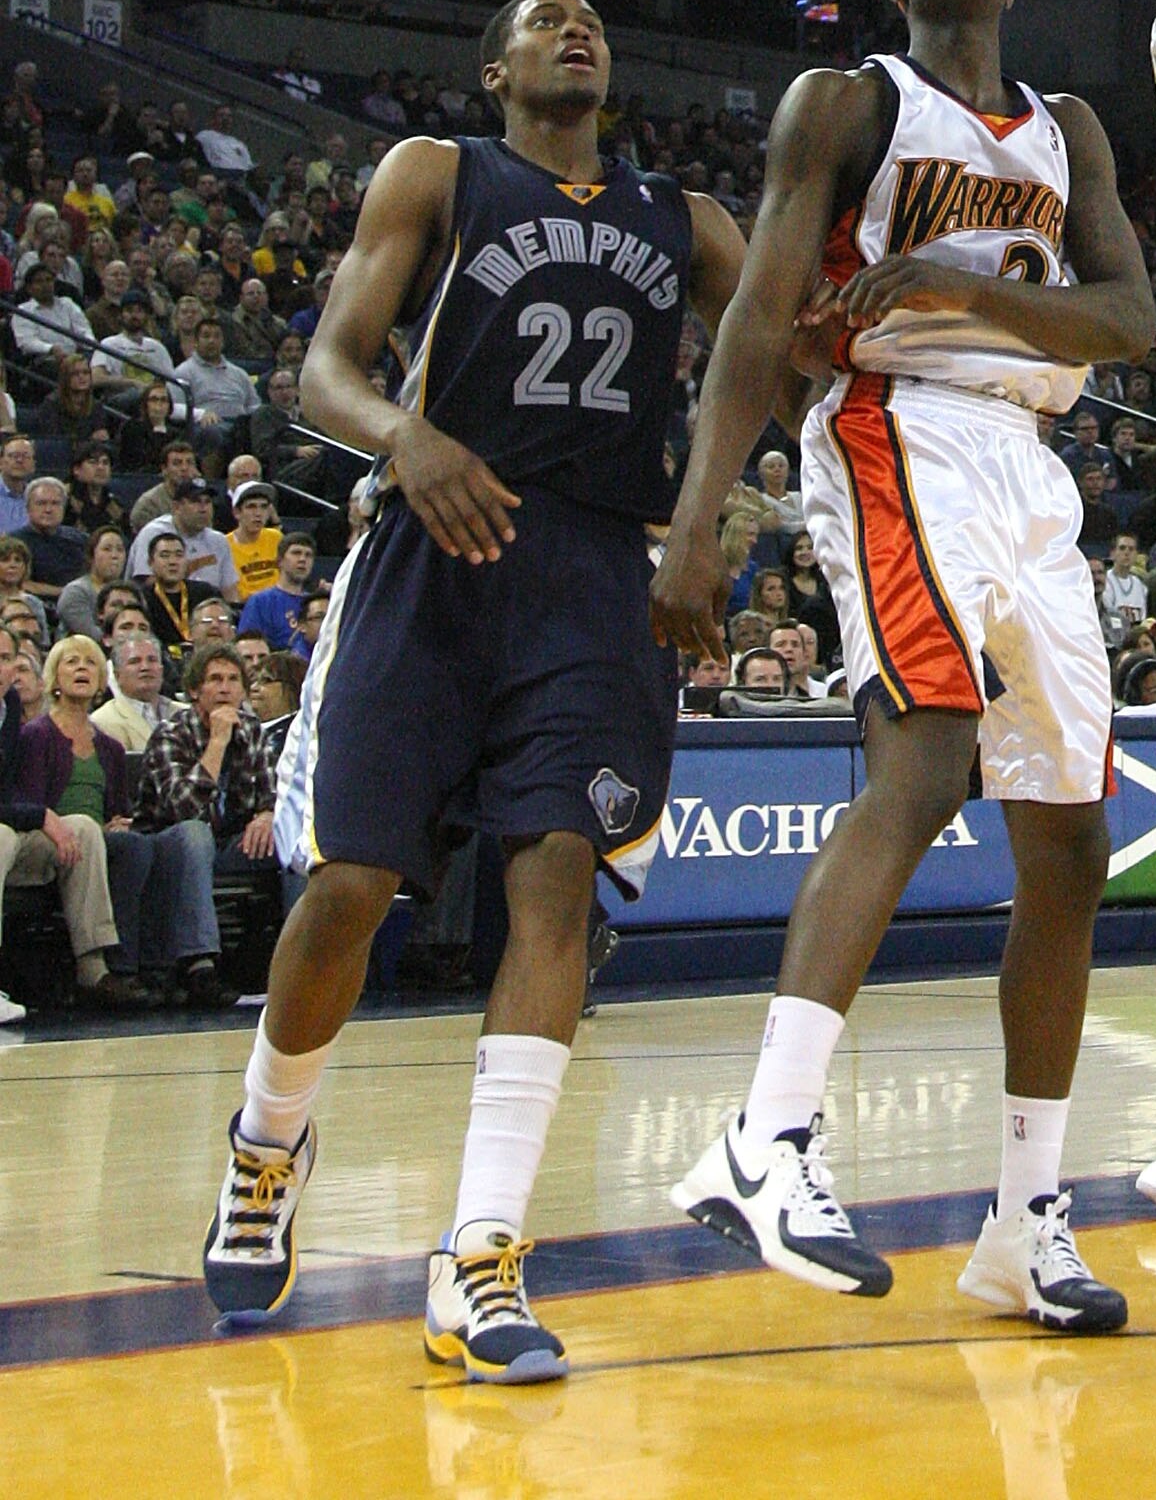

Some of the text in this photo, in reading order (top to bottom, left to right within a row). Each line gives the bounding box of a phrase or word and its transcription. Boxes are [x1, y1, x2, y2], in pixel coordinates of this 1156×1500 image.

[86, 17, 120, 41] 102
[463, 217, 680, 310] MEMPHIS
[513, 302, 633, 413] 22
